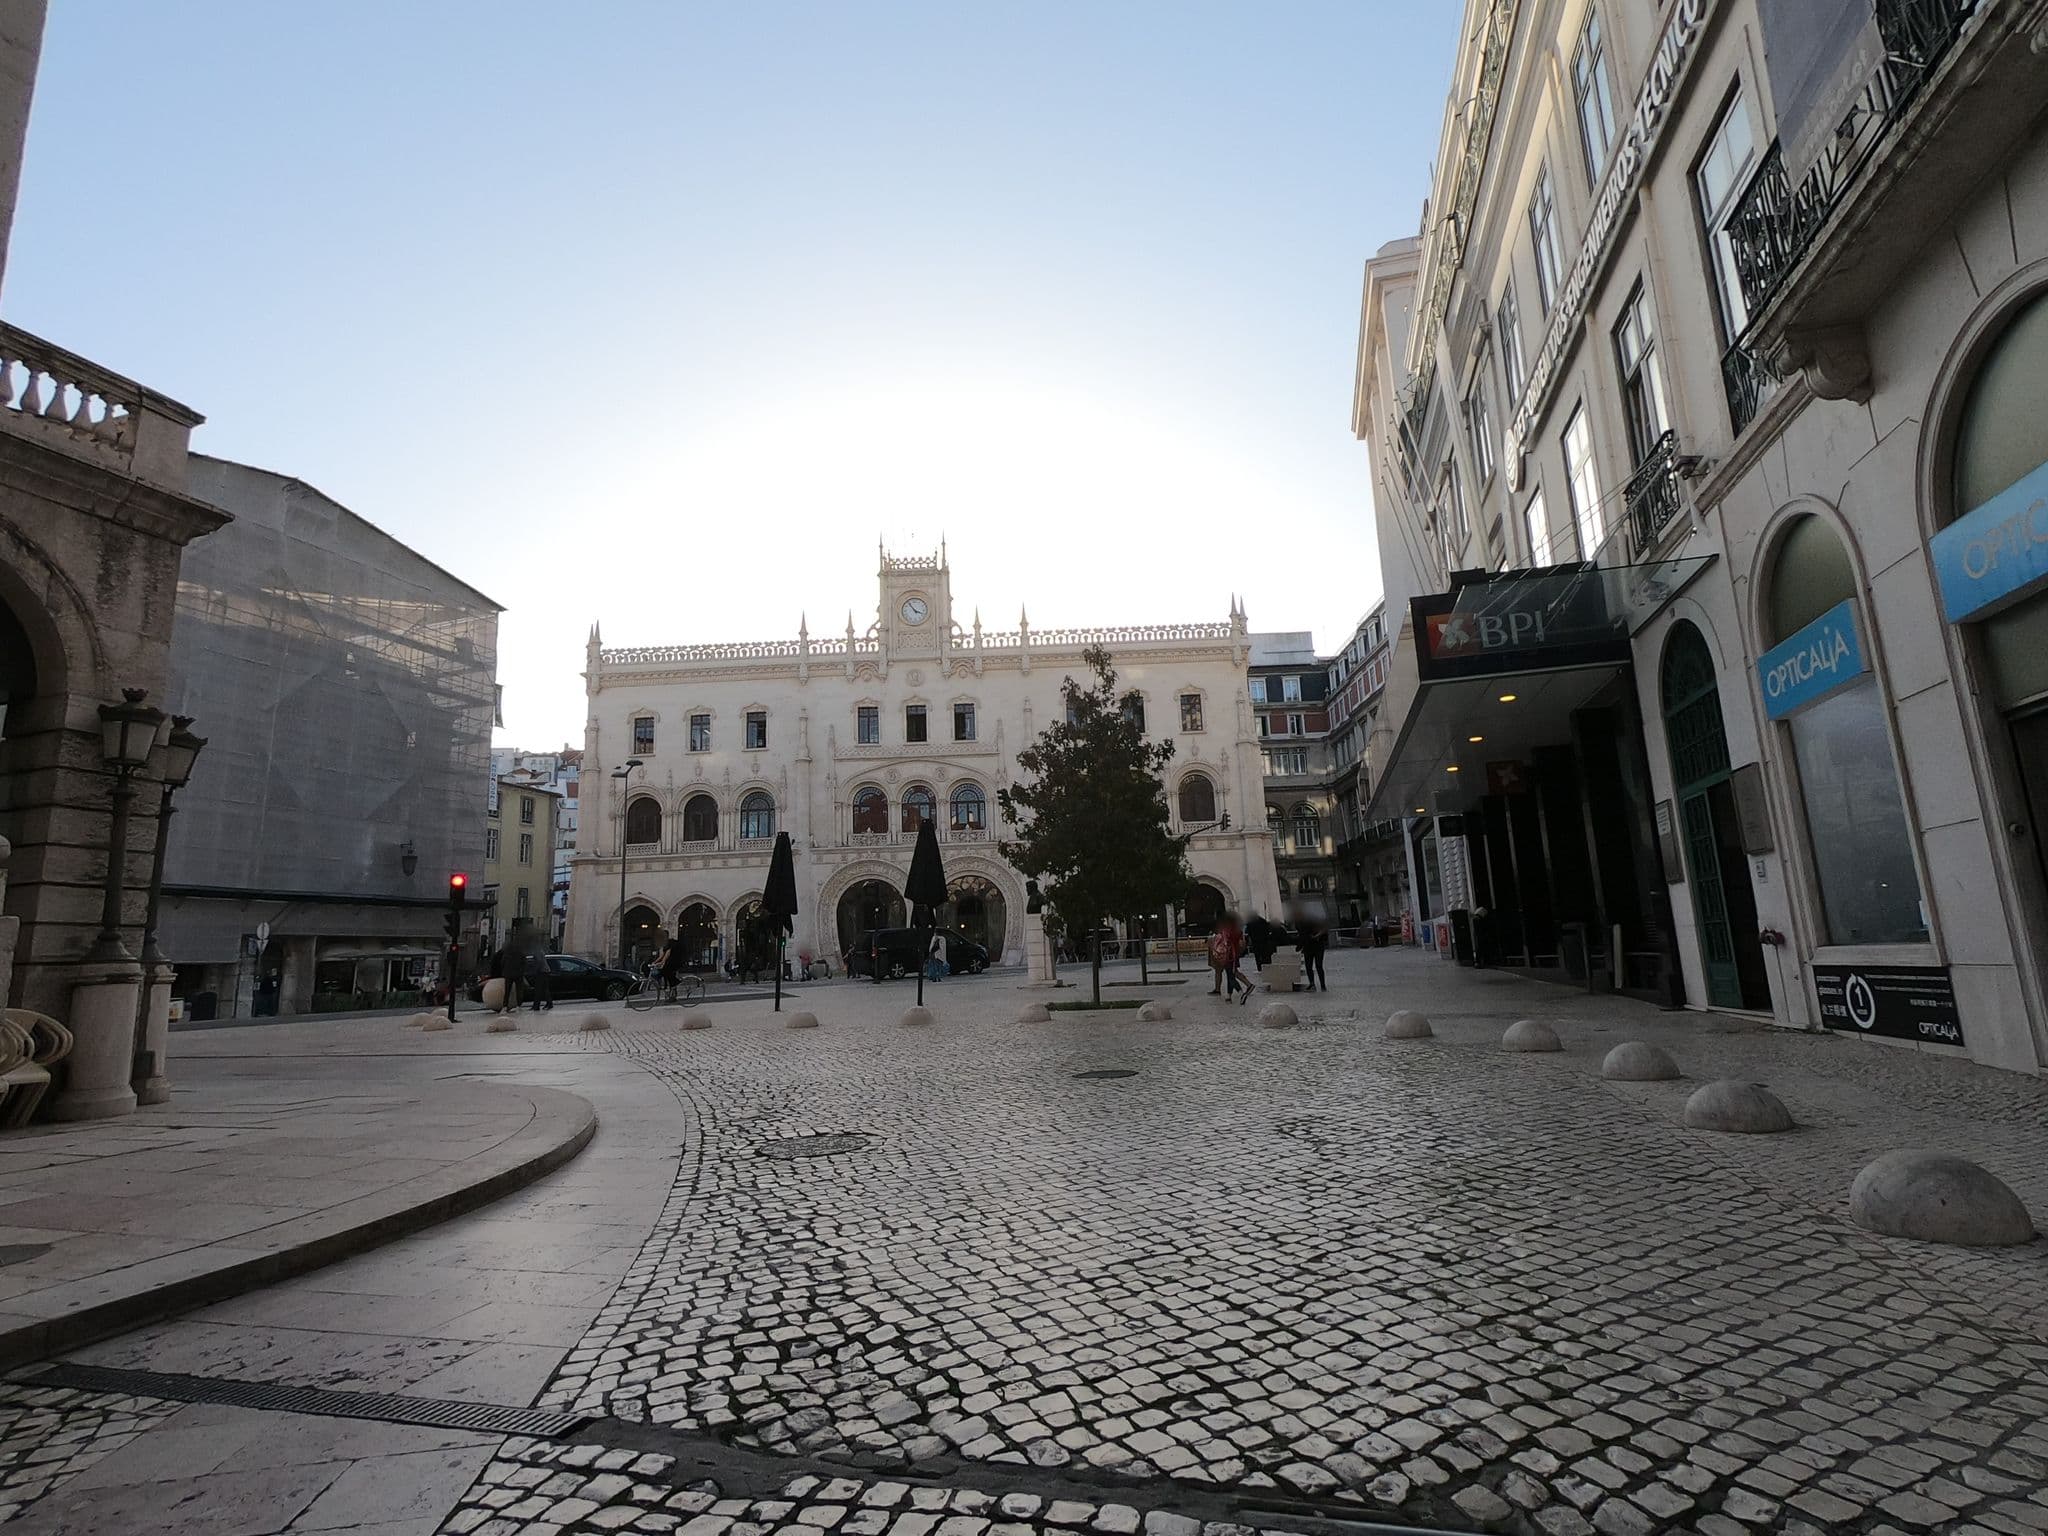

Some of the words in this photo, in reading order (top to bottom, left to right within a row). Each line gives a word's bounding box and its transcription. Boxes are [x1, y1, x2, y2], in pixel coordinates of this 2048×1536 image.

[1526, 343, 1552, 416] ORDEM
[1549, 306, 1568, 361] DOS
[1566, 130, 1636, 317] ENGENHEIROS
[1478, 610, 1545, 649] BPI
